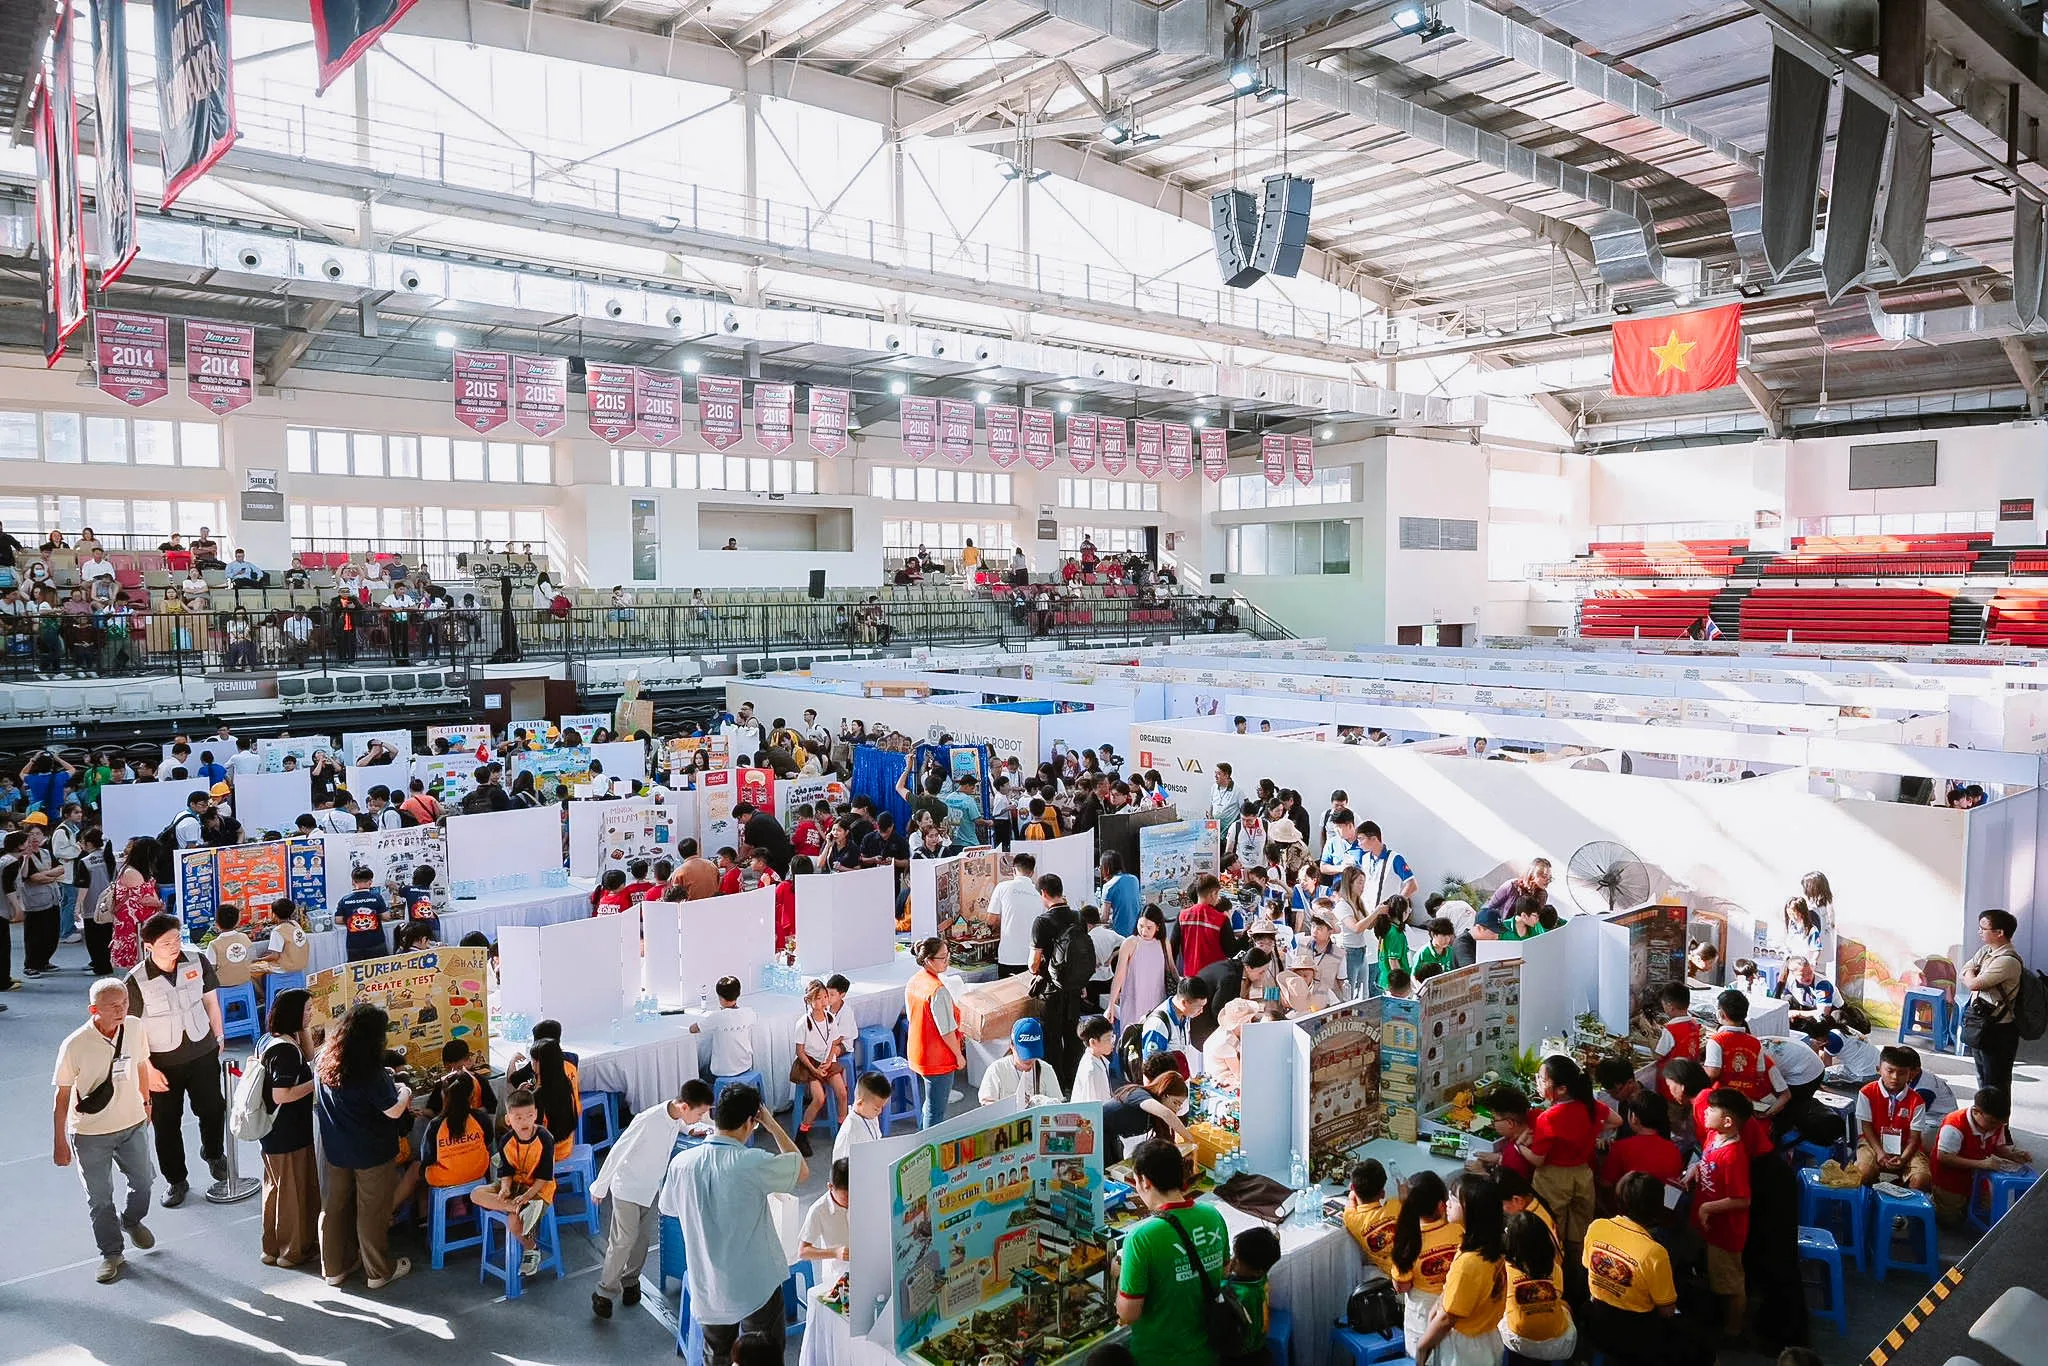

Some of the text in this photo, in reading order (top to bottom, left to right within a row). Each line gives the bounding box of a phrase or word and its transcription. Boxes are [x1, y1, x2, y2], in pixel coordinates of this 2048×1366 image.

[112, 347, 154, 367] 2014
[200, 356, 240, 376] 2014
[115, 377, 152, 385] CHAMPION
[466, 381, 498, 398] 2015
[526, 386, 556, 402] 2015
[596, 394, 626, 410] 2015
[646, 399, 673, 415] 2015
[708, 404, 734, 420] 2016
[763, 409, 786, 424] 2016
[817, 414, 840, 428] 2016
[910, 421, 930, 434] 2016
[948, 424, 968, 438] 2016
[993, 428, 1012, 442] 2017
[1030, 431, 1048, 444] 2017
[1072, 436, 1090, 448] 2017
[1104, 440, 1120, 451] 2017
[1142, 442, 1158, 454] 2017
[1170, 446, 1186, 457] 2017
[1206, 448, 1222, 459] 2017
[1268, 454, 1282, 464] 2017
[1296, 454, 1309, 464] 2017
[992, 737, 1022, 752] ROBOT
[1140, 734, 1172, 744] ORGANIZER
[1162, 782, 1188, 793] PONSOR
[454, 958, 484, 968] SHARE
[365, 980, 402, 993] CREATE
[413, 974, 436, 986] TEST
